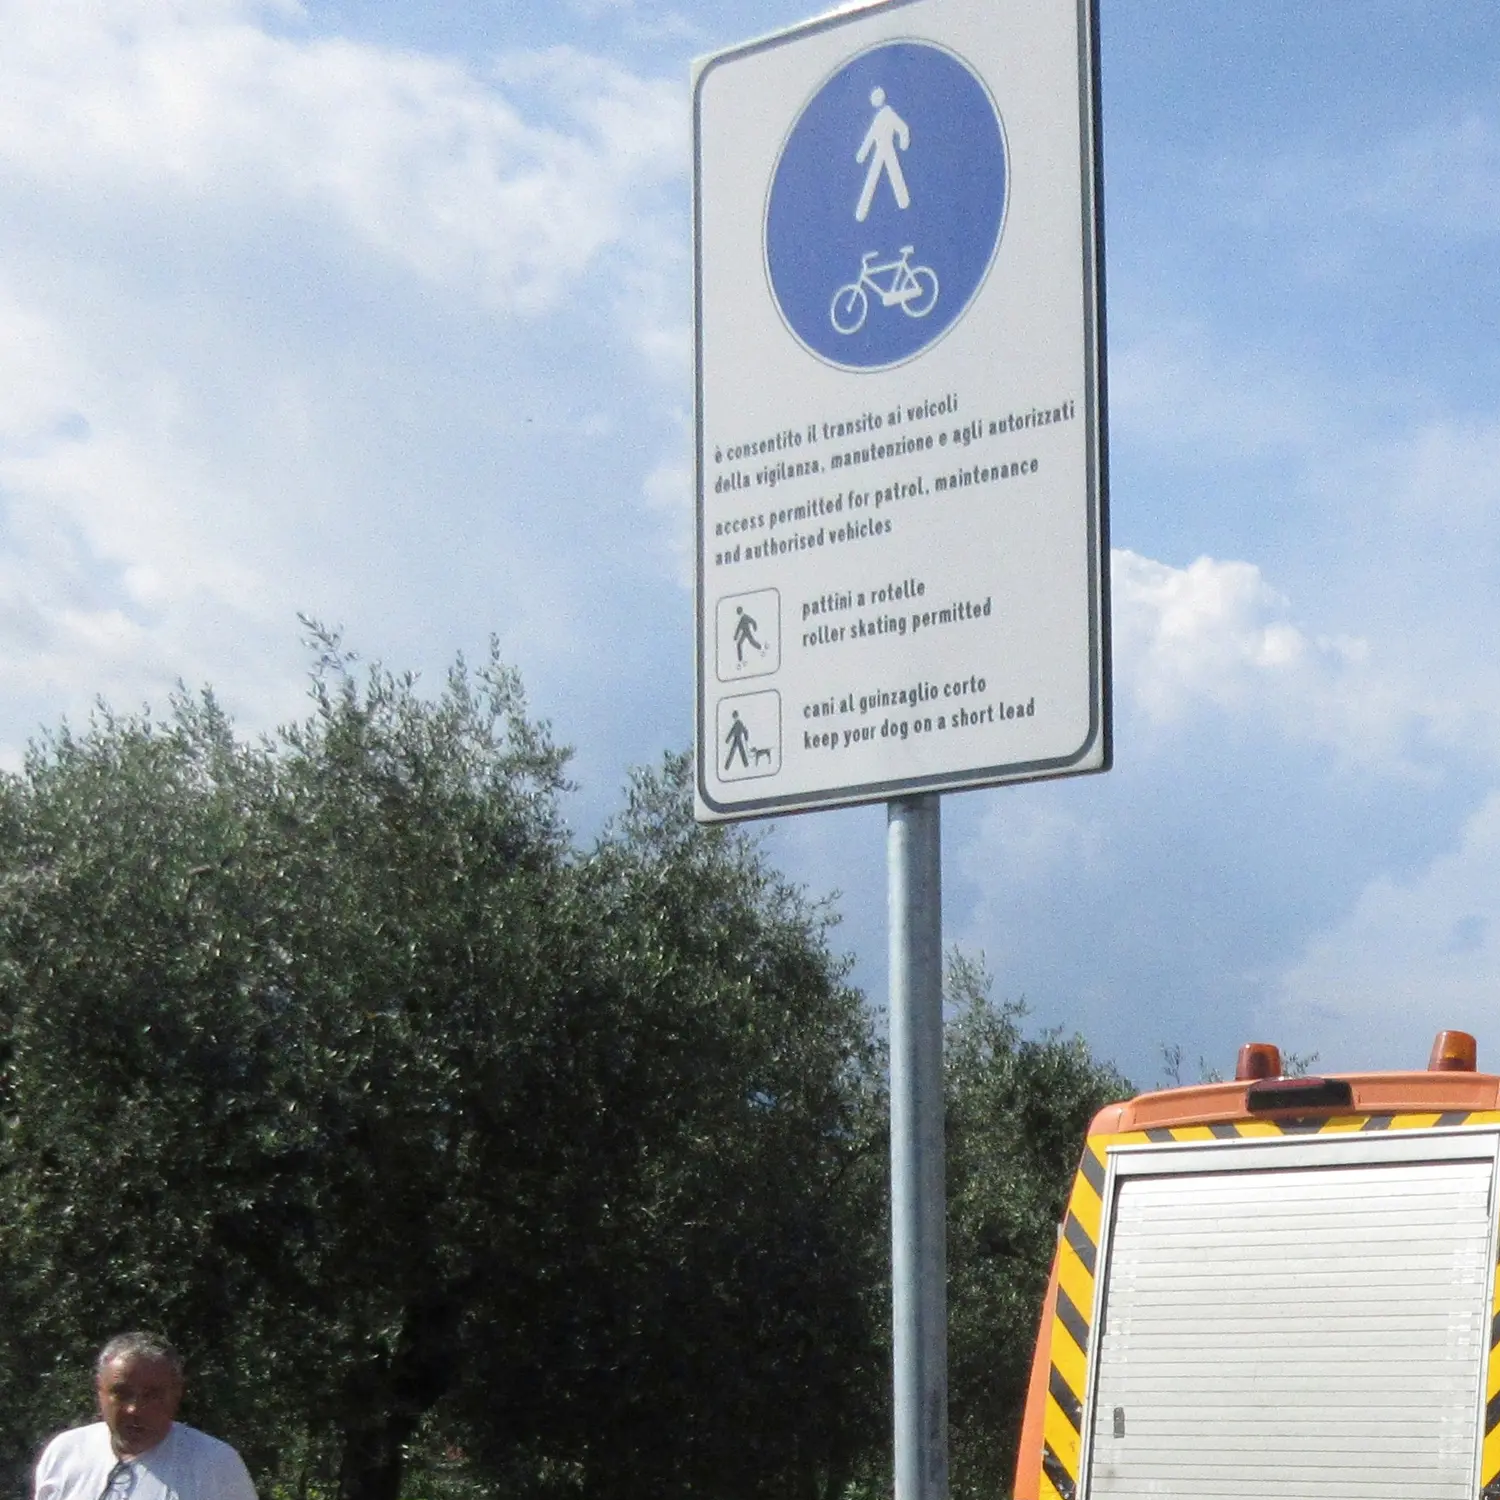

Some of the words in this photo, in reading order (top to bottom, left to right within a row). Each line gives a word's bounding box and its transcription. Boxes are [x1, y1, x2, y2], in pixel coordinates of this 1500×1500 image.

[714, 445, 723, 464] è
[726, 429, 803, 462] consentito
[807, 423, 818, 444] il
[821, 412, 883, 441] transito
[887, 404, 902, 427] ai
[906, 392, 958, 422] veicoli
[714, 470, 751, 495] della
[755, 459, 826, 488] vigilanza,
[830, 434, 934, 470] manutenzione
[938, 431, 948, 447] e
[952, 419, 983, 447] agli
[988, 399, 1075, 436] autorizzati
[715, 514, 765, 537] access
[769, 492, 843, 530] permitted
[847, 489, 870, 510] for
[874, 475, 930, 509] patrol,
[934, 458, 1039, 492] maintenance
[715, 544, 741, 566] and
[744, 527, 825, 561] authorised
[828, 517, 892, 545] vehicles
[802, 590, 853, 622] pattini
[856, 592, 866, 607] a
[870, 577, 926, 605] rotelle
[802, 624, 846, 648] roller
[850, 614, 907, 640] skating
[911, 596, 992, 634] permitted
[802, 696, 835, 720] cani
[839, 692, 856, 714] al
[858, 681, 939, 715] guinzaglio
[943, 674, 987, 698] corto
[803, 730, 840, 751] keep
[843, 725, 877, 749] your
[880, 718, 909, 741] dog
[912, 717, 933, 734] on
[937, 715, 947, 731] a
[951, 704, 995, 729] short
[999, 696, 1035, 721] lead
